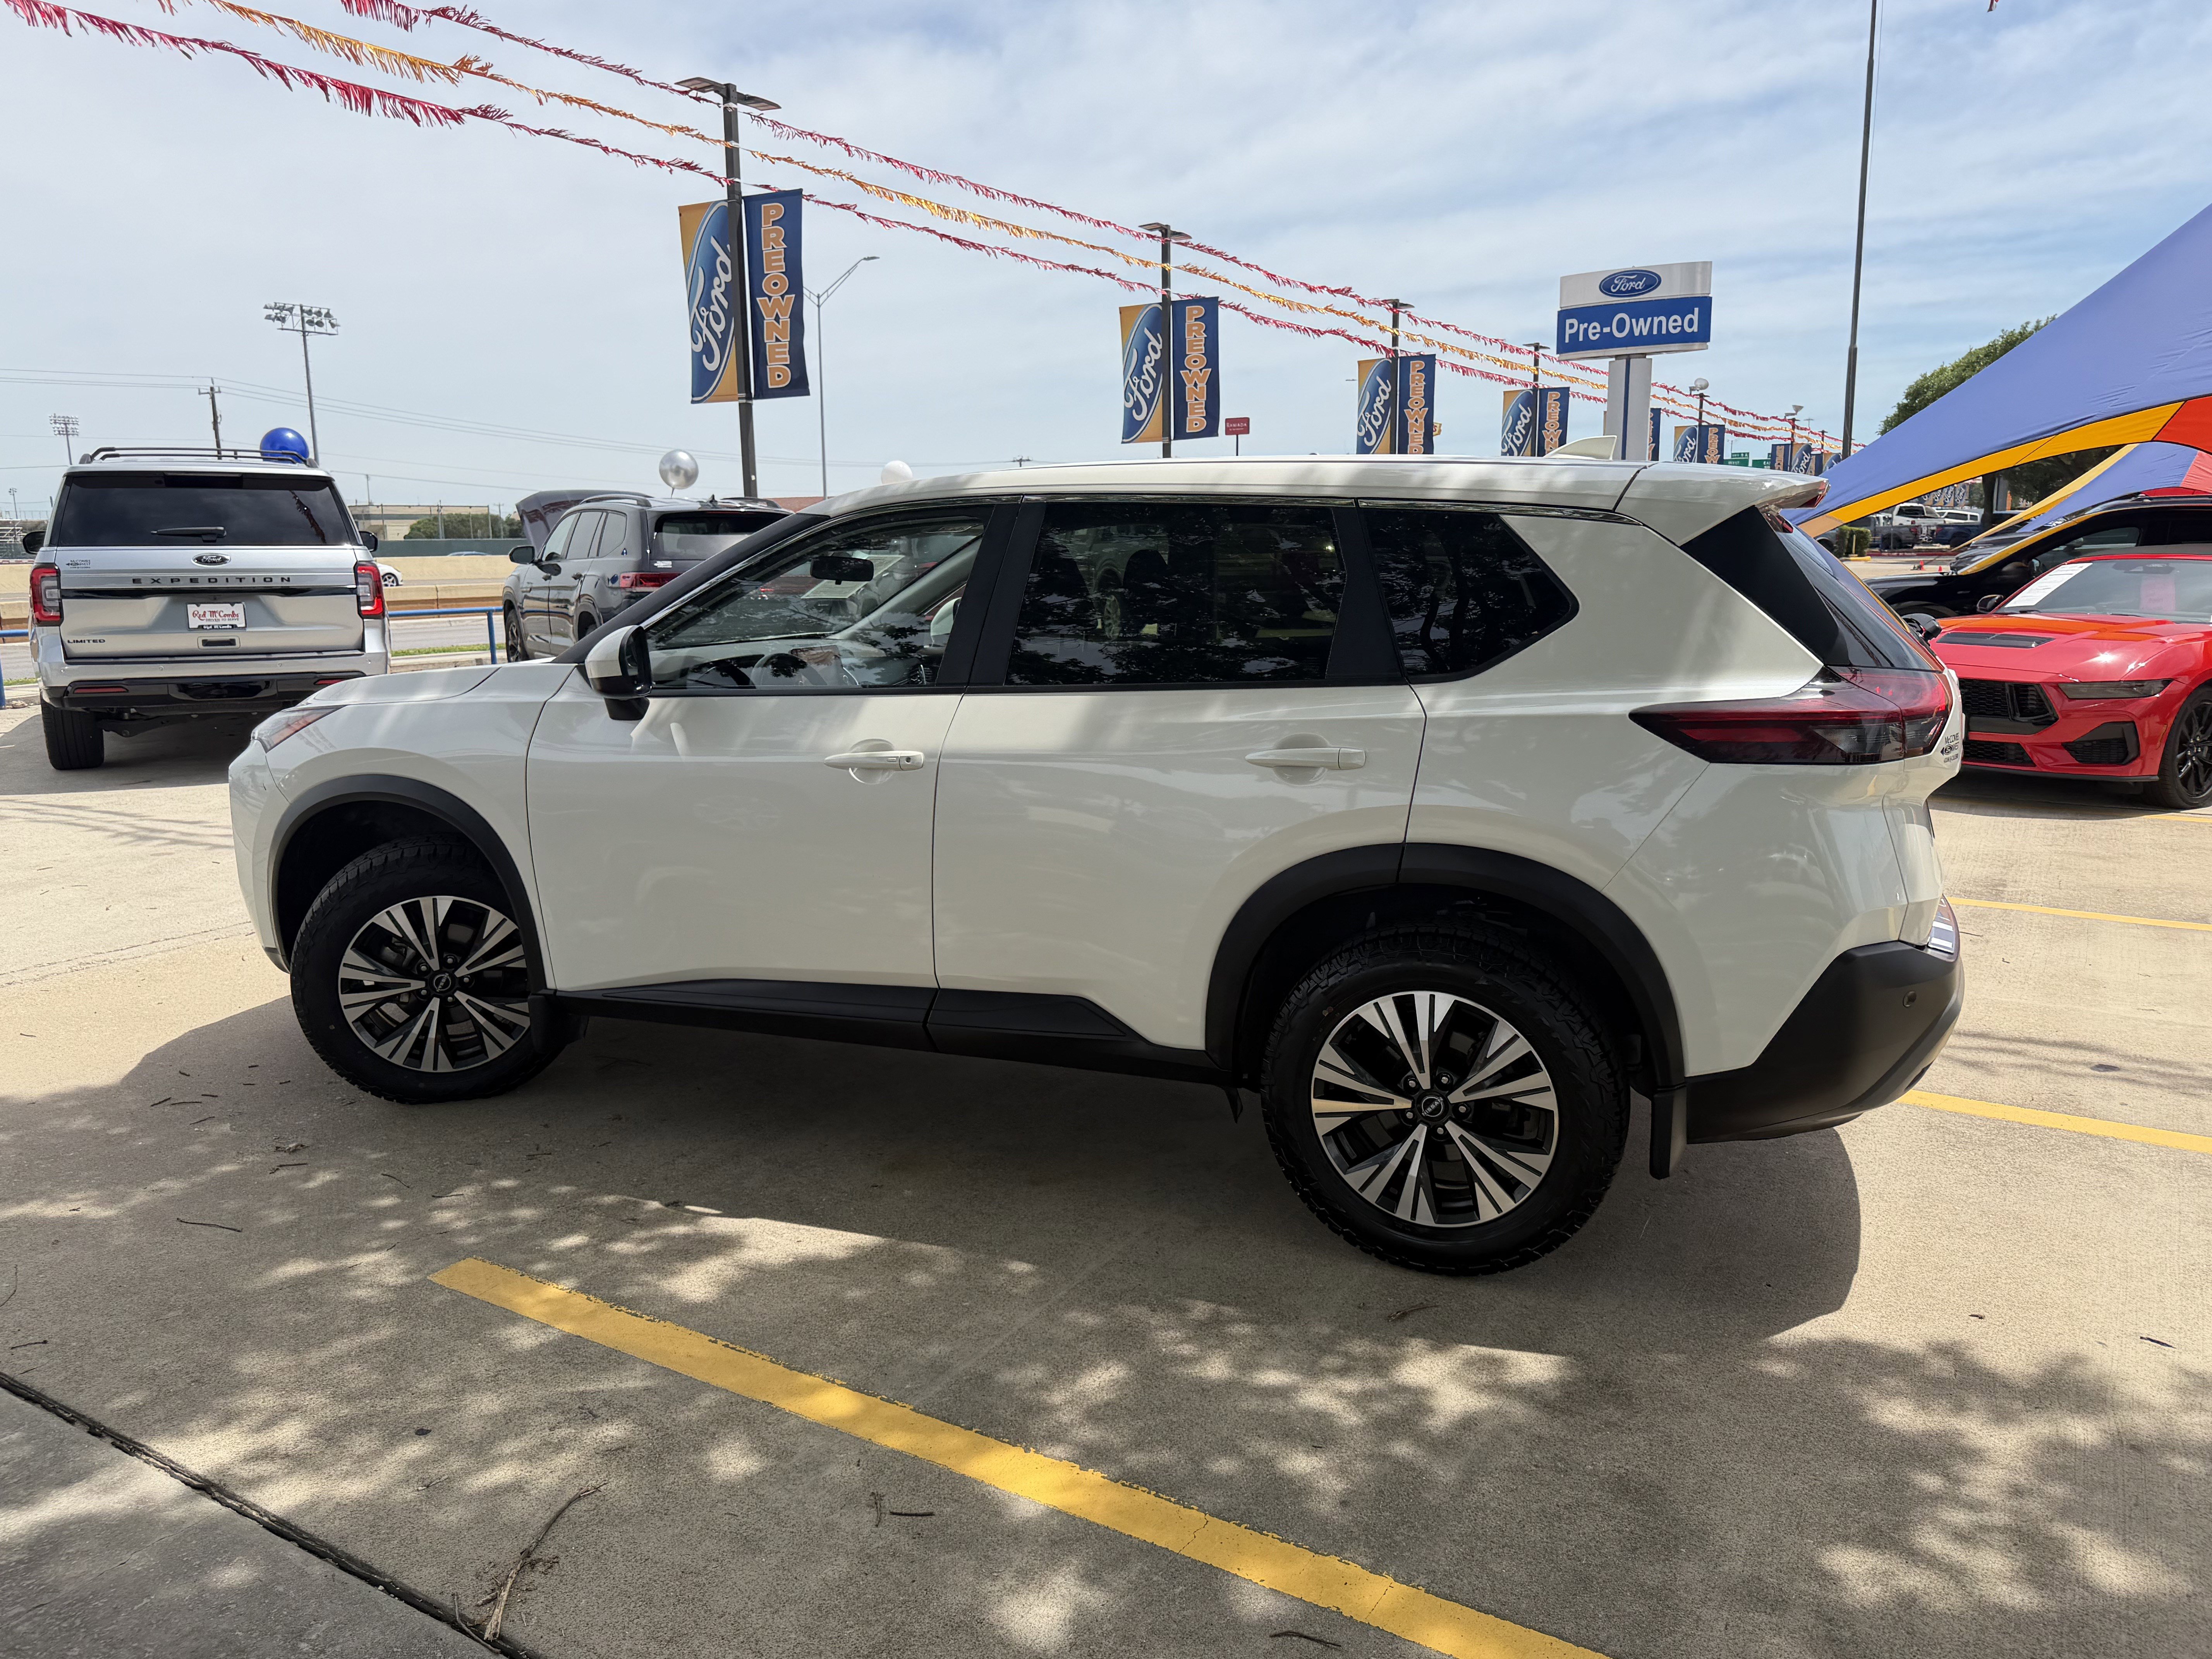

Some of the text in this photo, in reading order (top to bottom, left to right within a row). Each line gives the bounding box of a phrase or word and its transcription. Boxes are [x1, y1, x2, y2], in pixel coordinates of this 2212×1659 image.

[691, 235, 732, 371] Ford
[756, 203, 795, 388] PREOWNED
[1610, 275, 1646, 292] Ford
[1565, 307, 1699, 343] Pre-Owned
[1124, 327, 1162, 421] Ford
[1180, 306, 1212, 433] PREOWNED
[1357, 376, 1392, 446] Ford
[1501, 403, 1532, 456] Ford
[192, 610, 206, 621] Red
[1421, 1097, 1444, 1116] NISSAN
